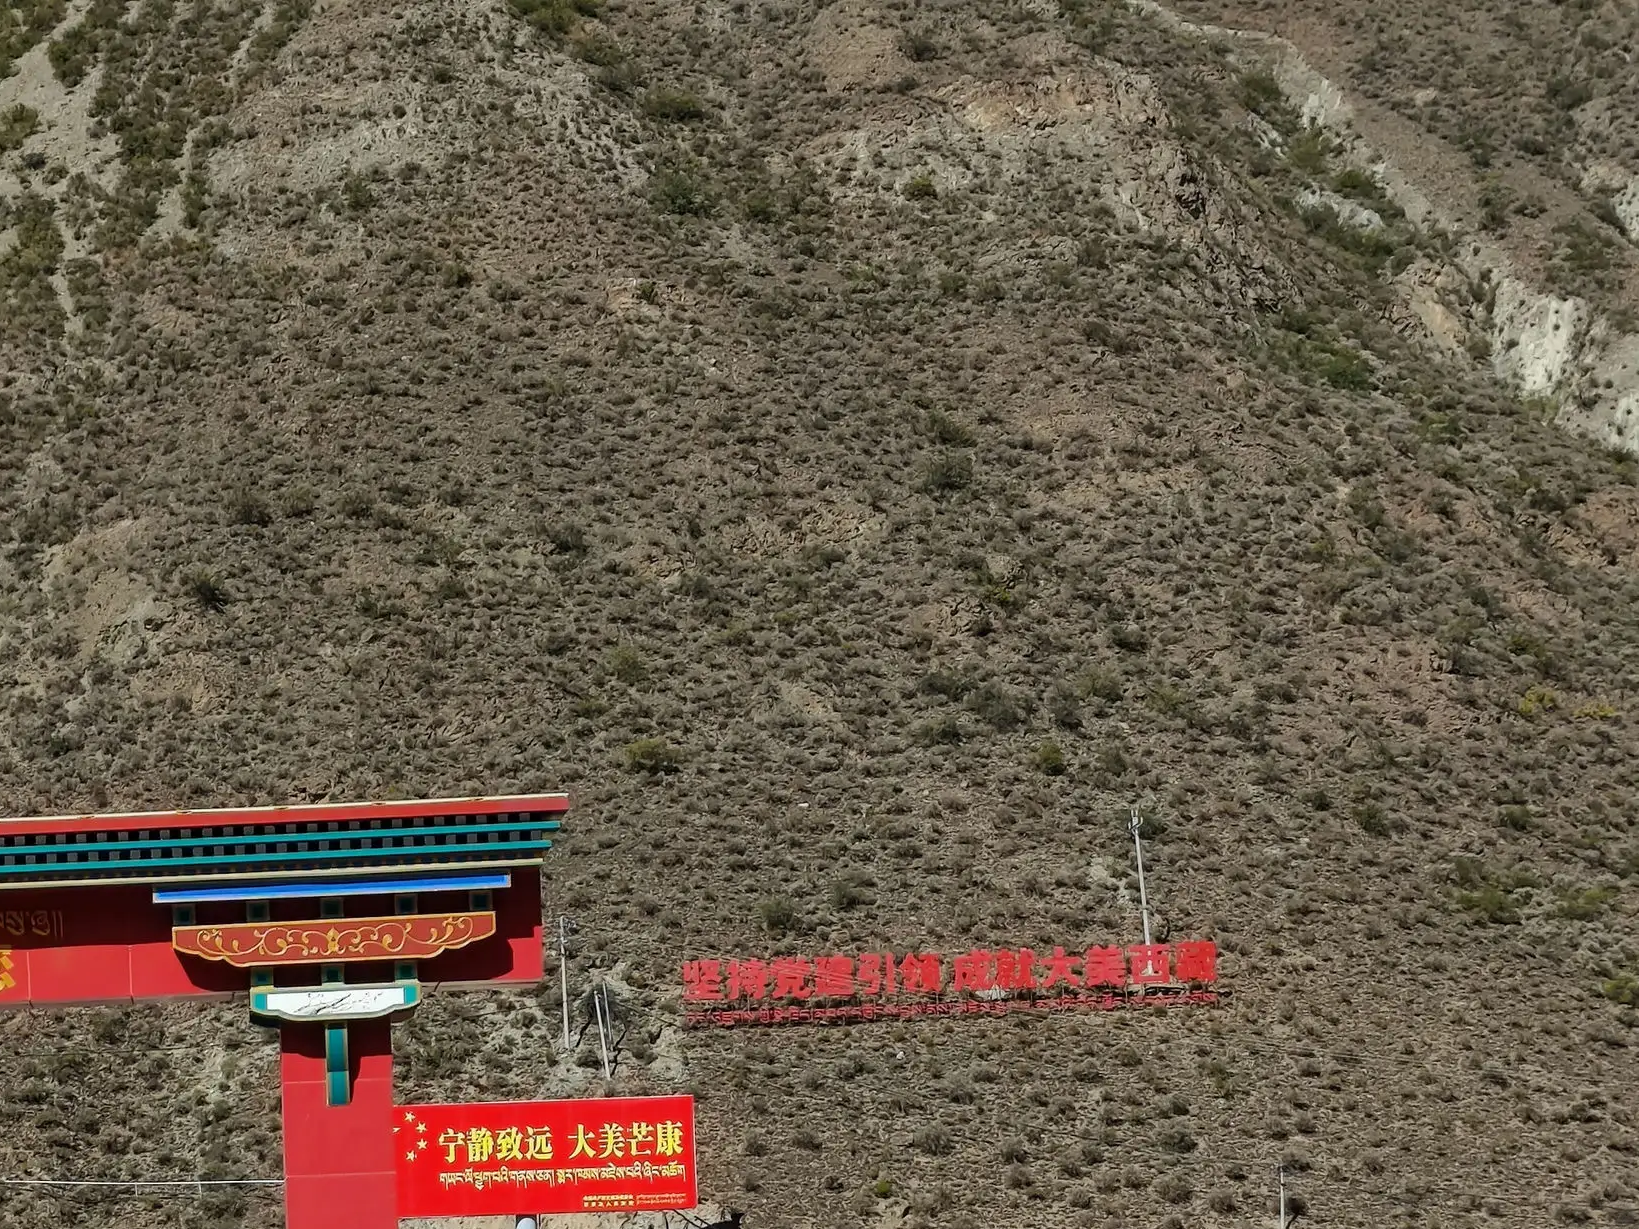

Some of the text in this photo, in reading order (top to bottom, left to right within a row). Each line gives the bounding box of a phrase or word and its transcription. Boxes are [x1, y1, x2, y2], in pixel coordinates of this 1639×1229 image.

[437, 1120, 684, 1163] 宁静致远 大美芒康
